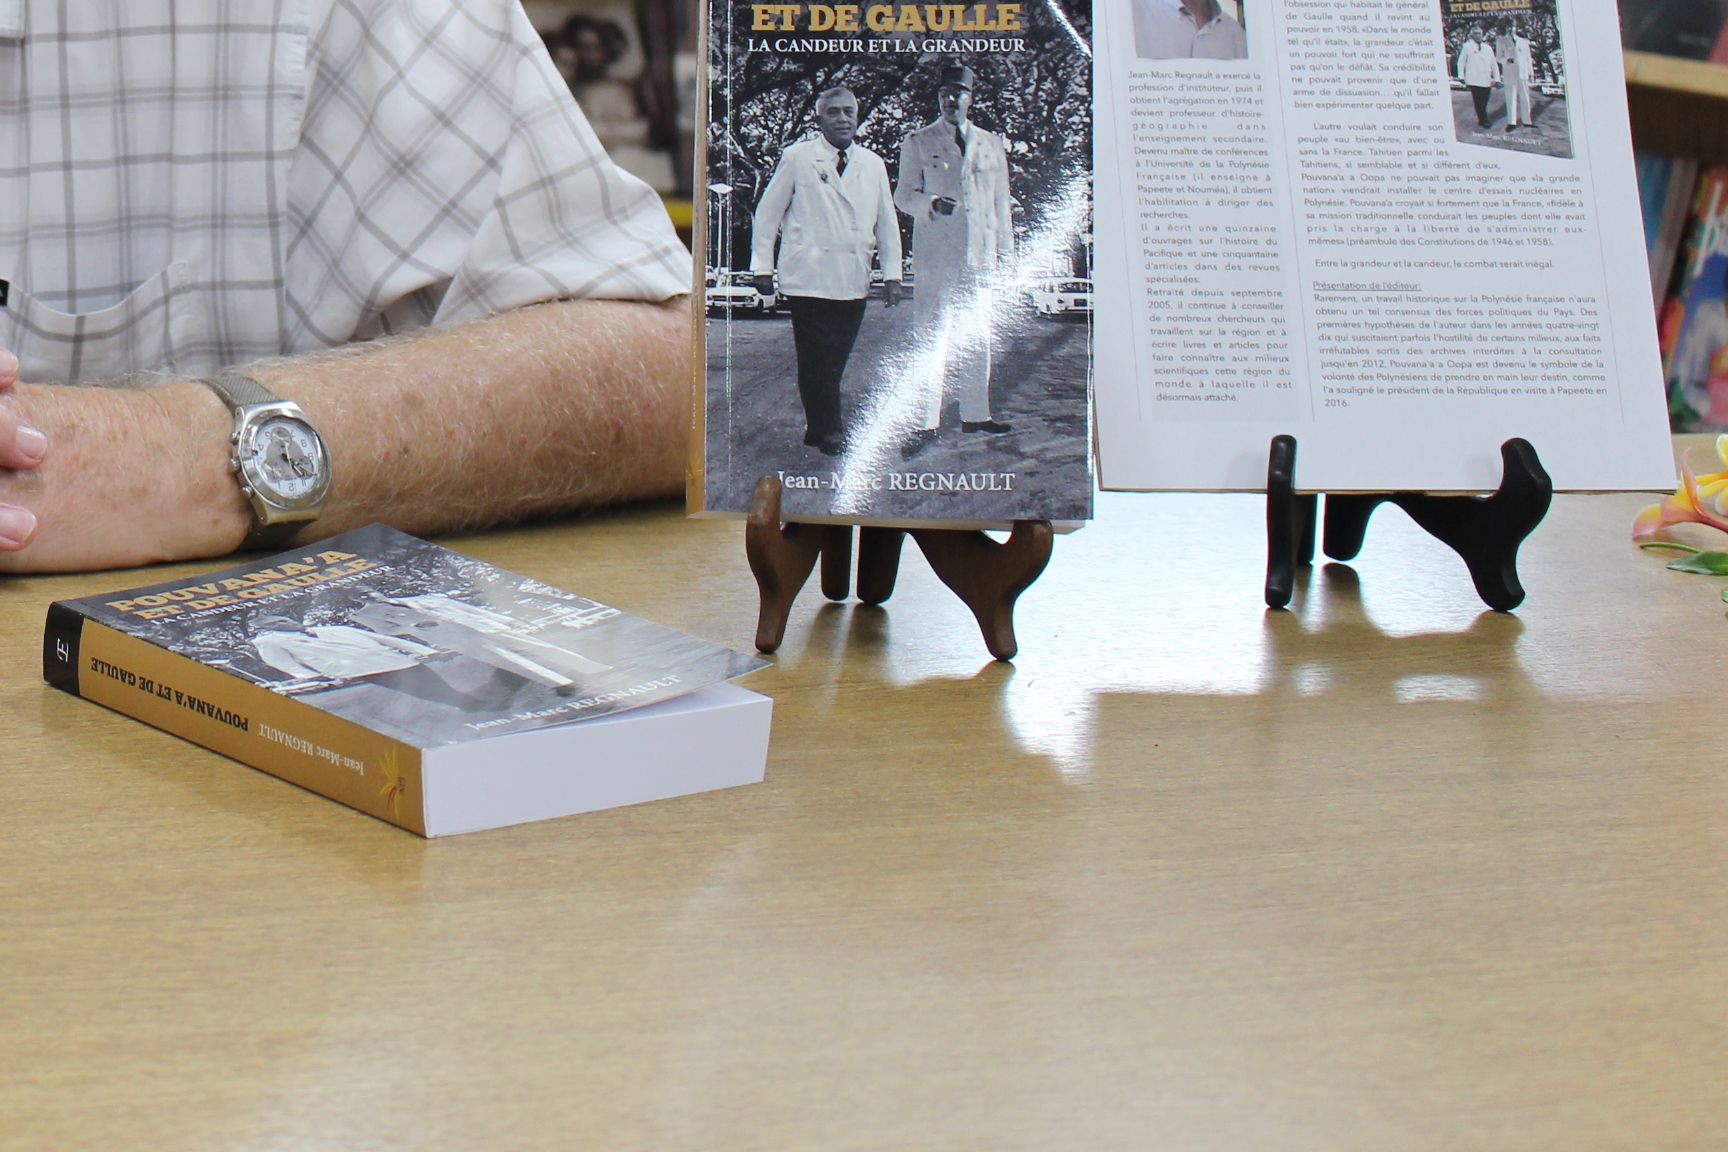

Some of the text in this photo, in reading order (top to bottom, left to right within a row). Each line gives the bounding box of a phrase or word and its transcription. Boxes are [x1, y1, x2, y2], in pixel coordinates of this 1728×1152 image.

[1334, 0, 1348, 10] qui
[1350, 0, 1383, 9] habitait
[1385, 0, 1393, 9] le
[1395, 0, 1429, 12] général
[751, 3, 1021, 31] ET DE GAULLE
[1285, 11, 1430, 23] de Gaulle quand il revint au
[748, 38, 1025, 53] LA CANDEUR ET LA GRANDEUR
[1128, 70, 1173, 80] Jean-Marc
[1175, 70, 1213, 82] Regnault
[1223, 71, 1251, 81] exercé
[1253, 71, 1261, 81] la
[1129, 82, 1262, 95] profession d'instituteur, puis il
[1130, 95, 1161, 105] obtient
[1163, 95, 1215, 107] l'agrégation
[1231, 96, 1252, 105] 1974
[1255, 98, 1264, 106] et
[1131, 108, 1264, 120] devient professeur d'histoire-
[1132, 121, 1266, 132] géographie dans
[1133, 133, 1267, 145] l'enseignement secondaire.
[1315, 259, 1555, 272] Entre la grandeur et la candeur, le combat serait inégal.
[1312, 281, 1367, 291] Présentation
[1369, 281, 1381, 291] de
[888, 473, 1015, 492] REGNAULT
[106, 550, 357, 612] POUVANA'A
[132, 558, 378, 620] ET DE GAULLE
[151, 565, 395, 626] LA CANDEUR ET LA GRANDEUR
[90, 657, 249, 731] POUVANA'A ET DE GAULLE
[464, 675, 683, 731] Jean-Marc REGNAULT
[258, 723, 365, 776] Jean-Marc REGNAULT
